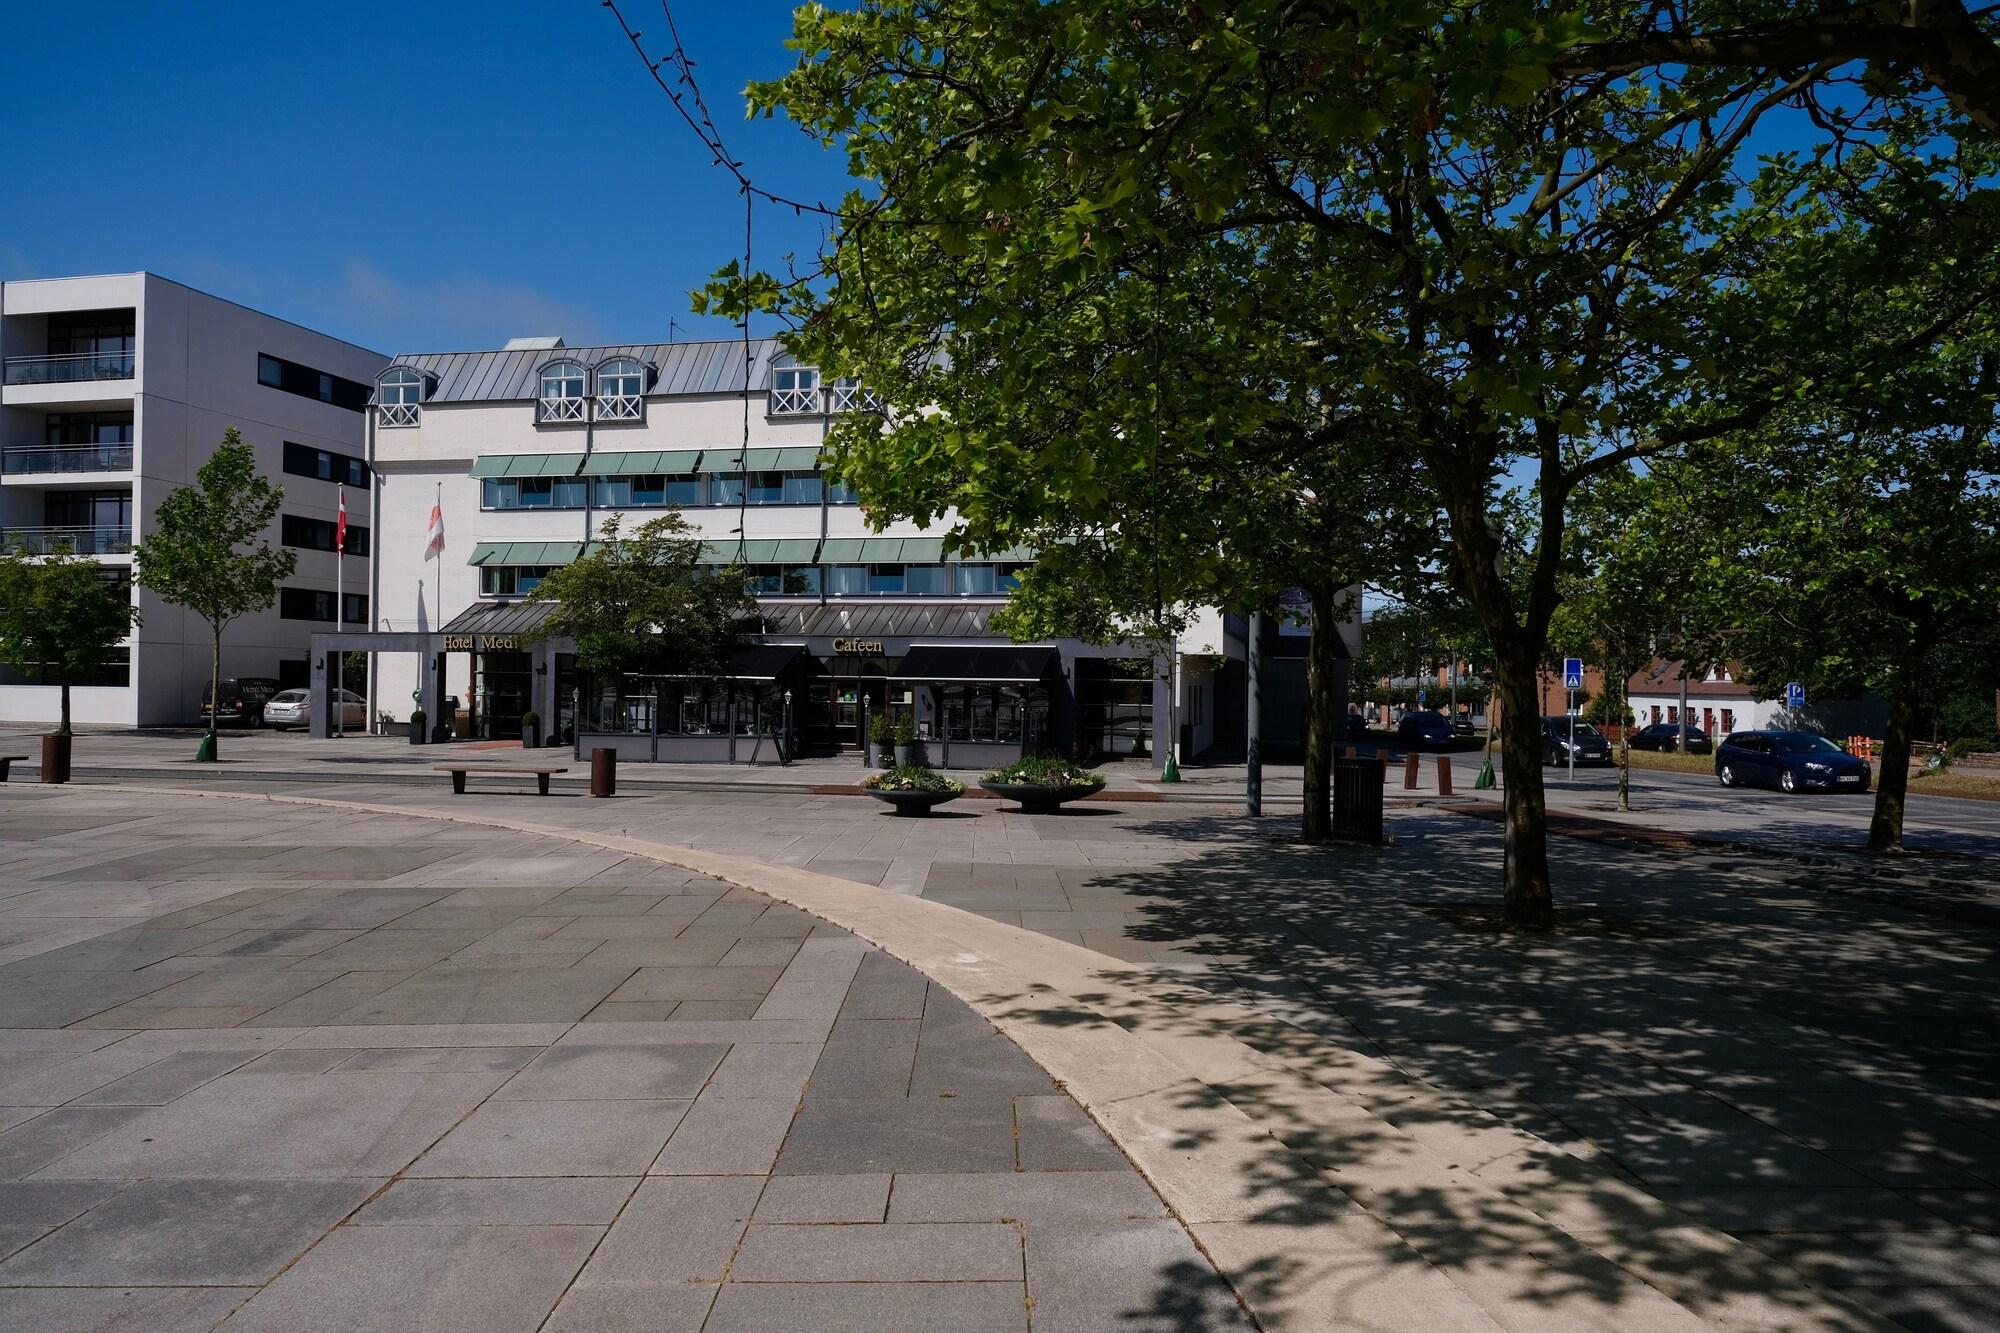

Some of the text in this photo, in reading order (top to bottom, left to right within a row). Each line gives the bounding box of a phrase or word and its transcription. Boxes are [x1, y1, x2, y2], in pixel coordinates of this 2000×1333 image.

[443, 635, 473, 649] Hotel
[832, 638, 882, 652] Cafeen
[1792, 685, 1801, 697] P
